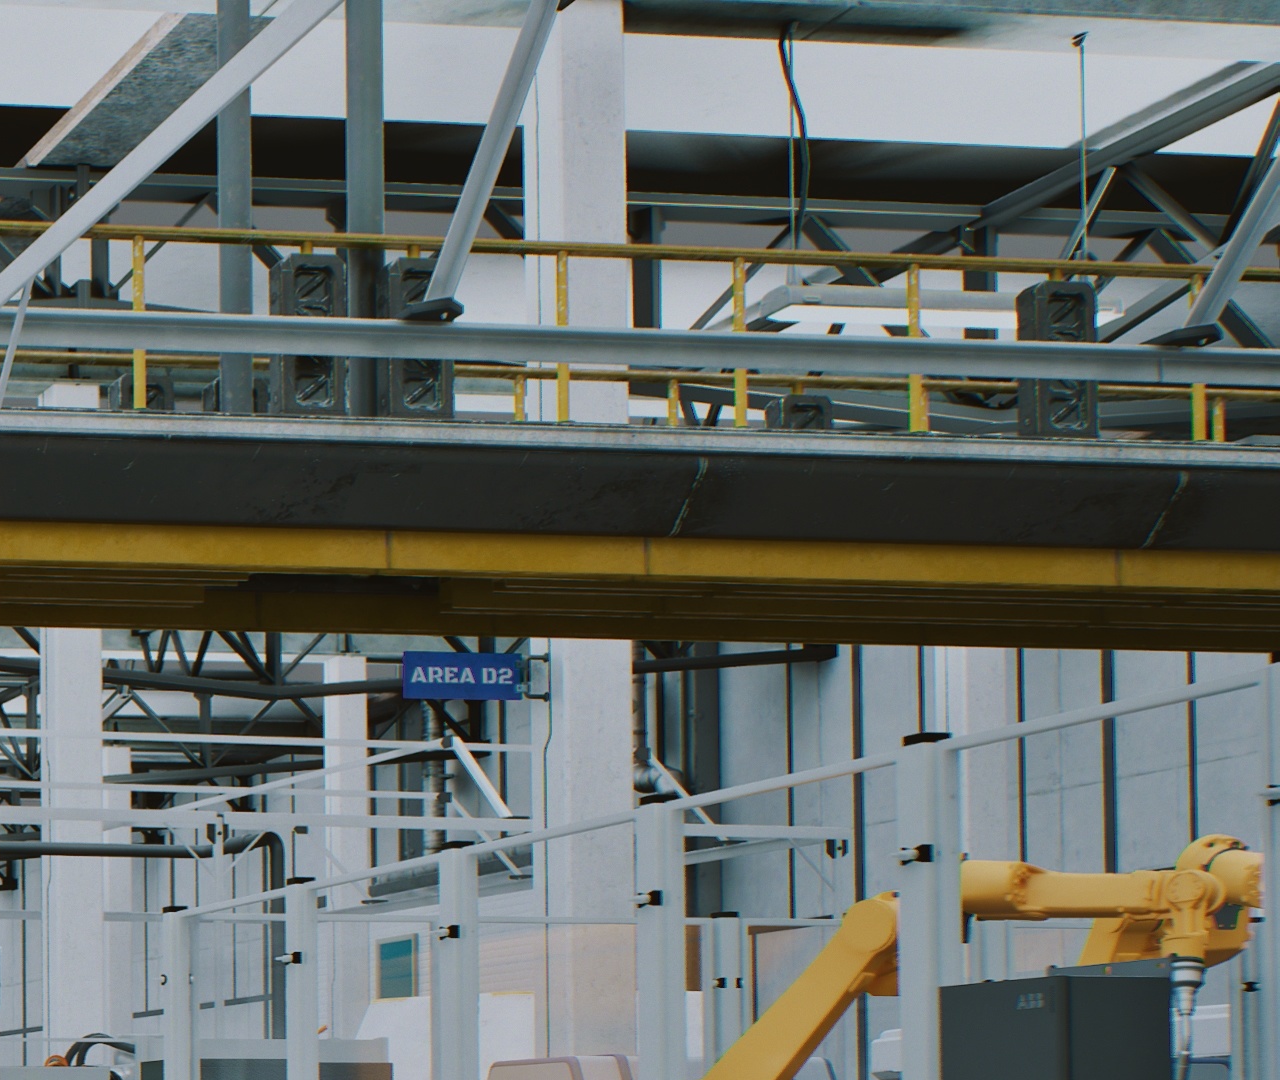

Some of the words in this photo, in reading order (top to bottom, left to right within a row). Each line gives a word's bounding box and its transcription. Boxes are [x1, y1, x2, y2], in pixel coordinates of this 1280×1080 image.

[411, 666, 475, 684] AREA
[482, 667, 513, 684] D2
[1016, 993, 1045, 1010] ABB
